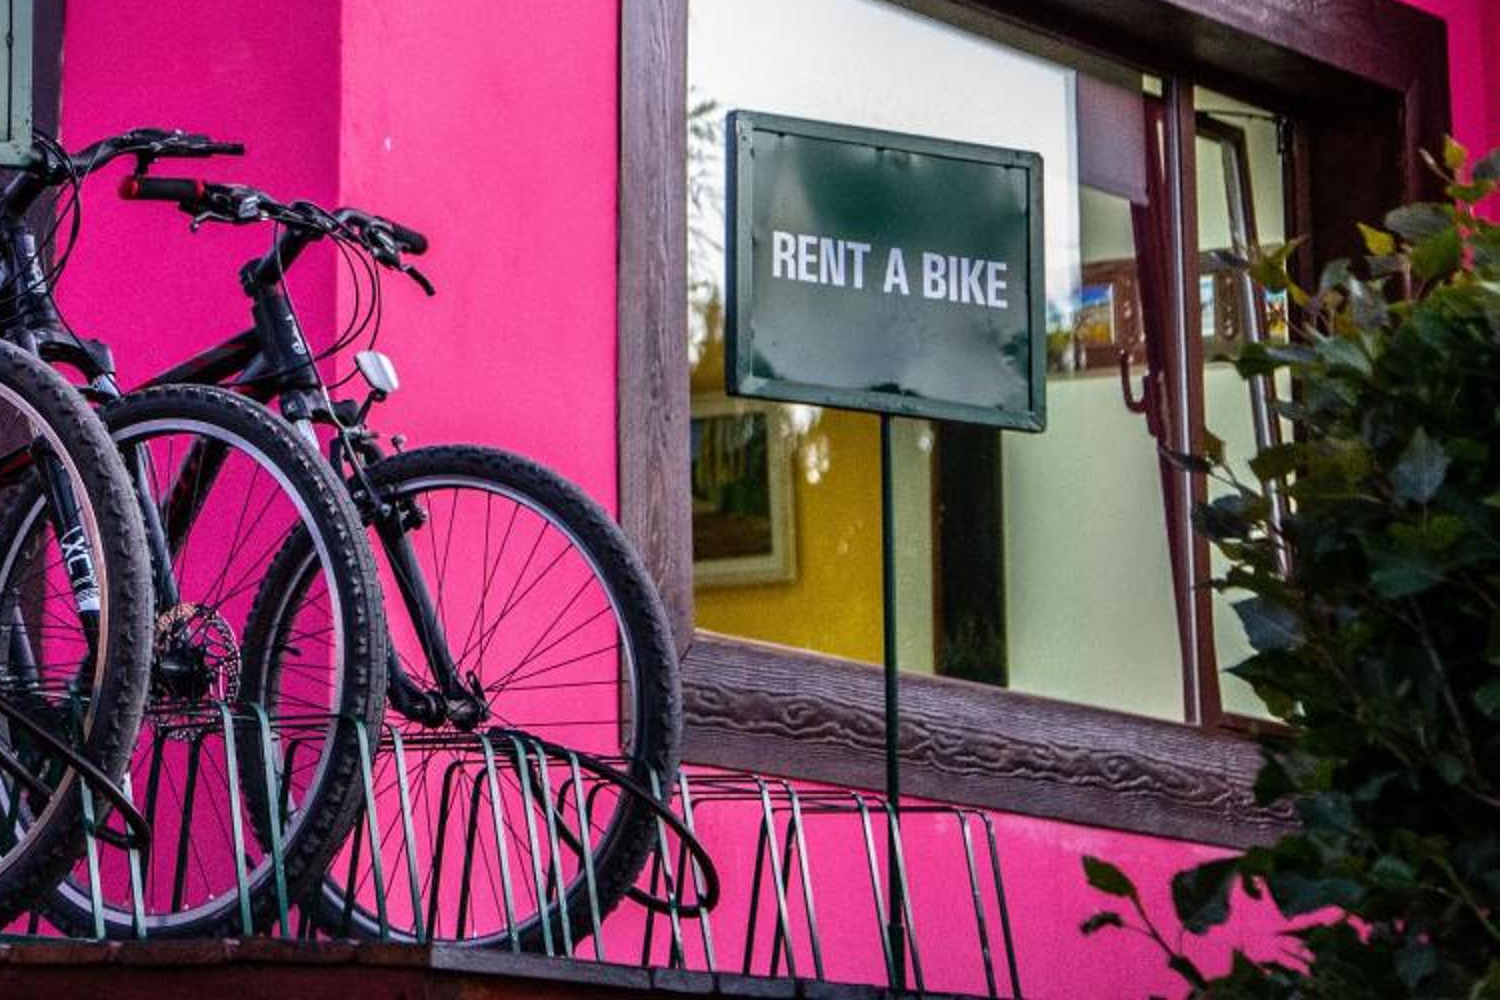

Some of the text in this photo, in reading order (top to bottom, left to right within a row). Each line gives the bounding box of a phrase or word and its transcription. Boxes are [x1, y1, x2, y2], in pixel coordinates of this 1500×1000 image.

[772, 230, 1008, 309] RENT A BIKE
